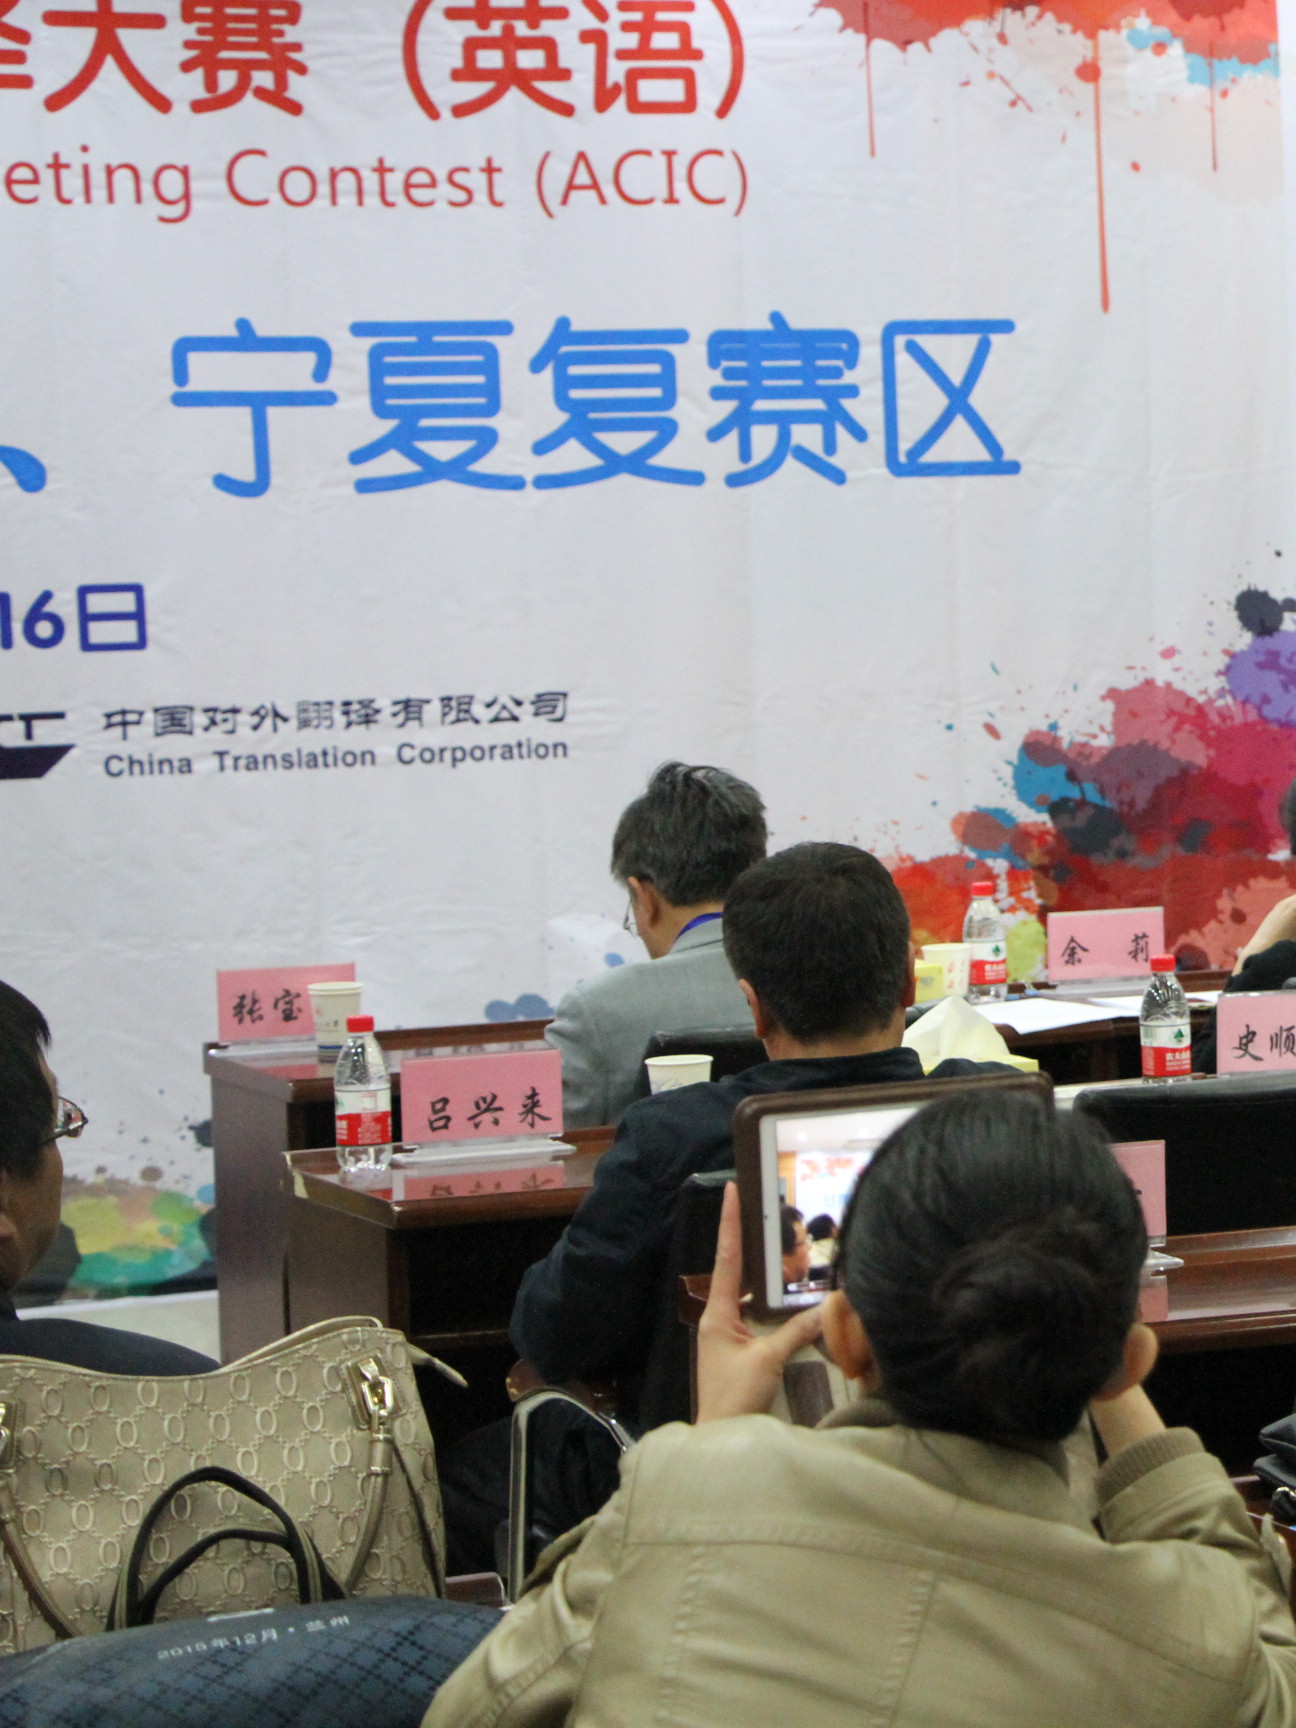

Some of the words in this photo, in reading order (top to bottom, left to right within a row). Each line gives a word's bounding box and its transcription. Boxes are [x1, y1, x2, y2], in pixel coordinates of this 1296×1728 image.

[225, 150, 505, 208] Contest
[536, 149, 748, 219] (ACIC)
[0, 582, 147, 653] 16日
[102, 691, 569, 741] 中国对外翻译有限公司
[104, 752, 193, 778] China
[213, 745, 377, 772] Translation
[396, 737, 569, 769] Corporation
[428, 1086, 552, 1133] 吕兴来
